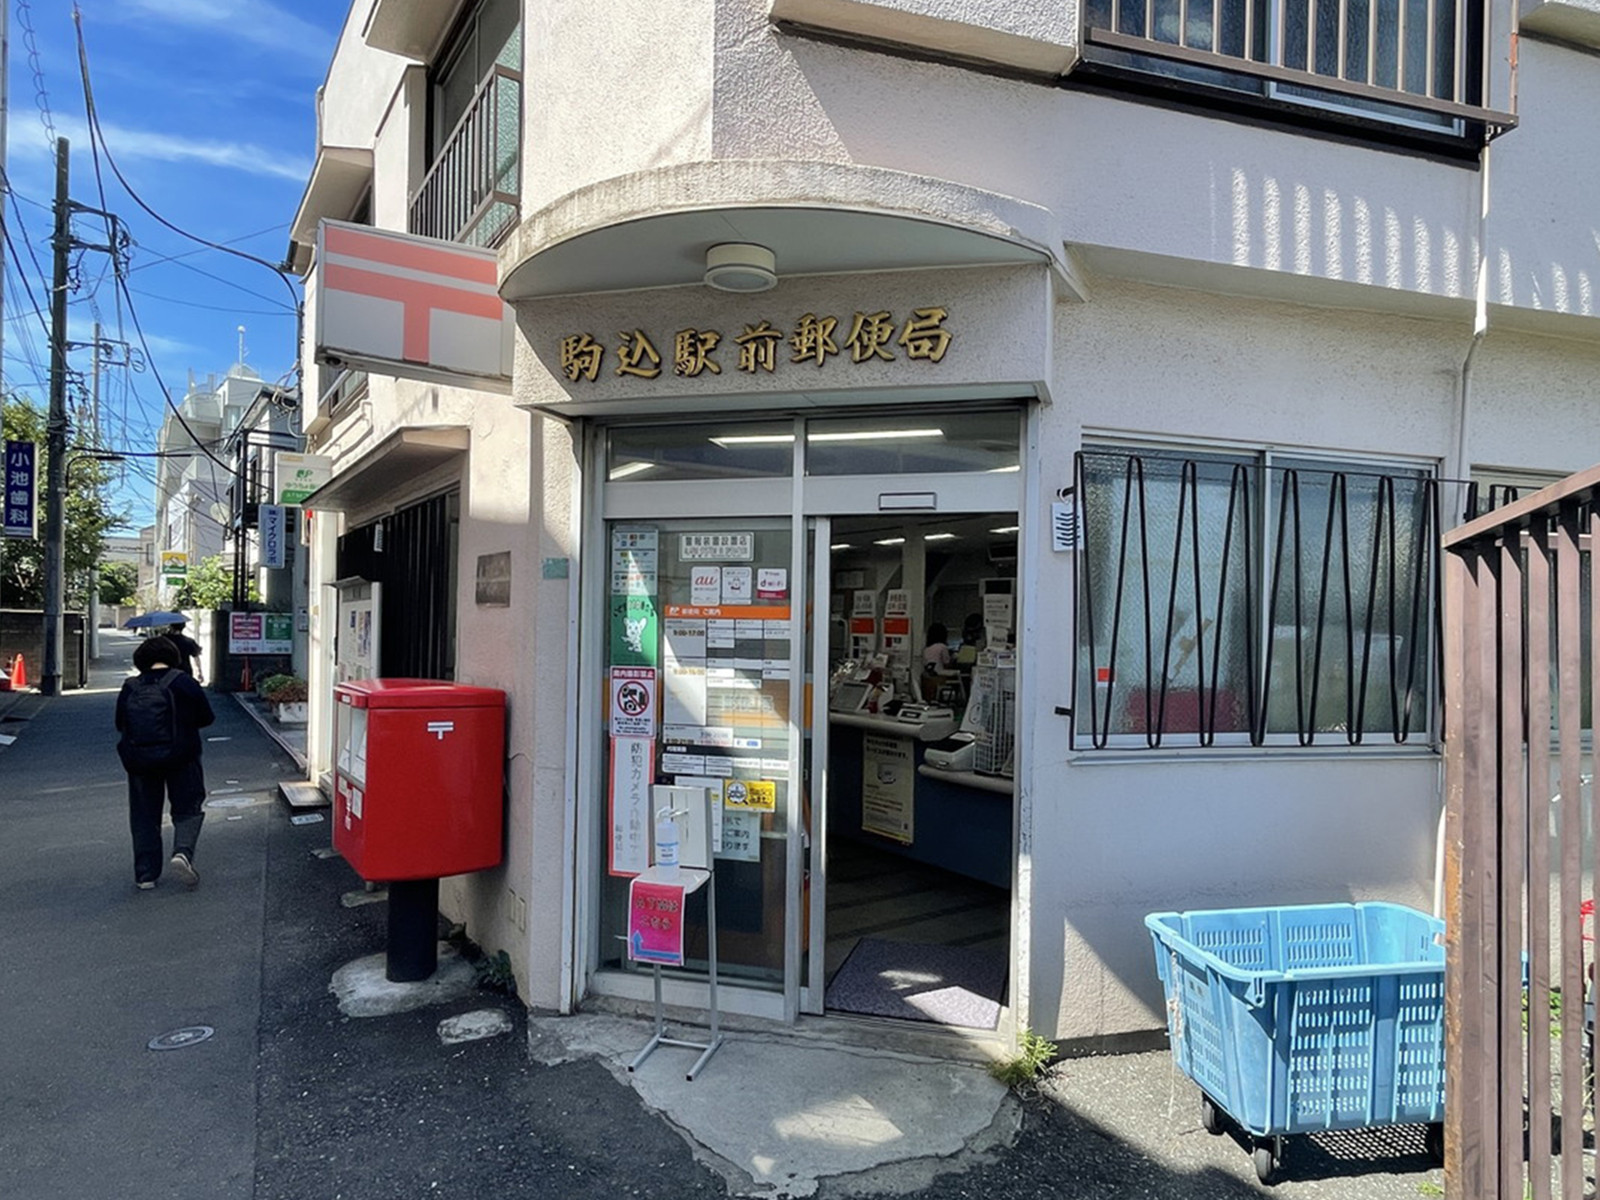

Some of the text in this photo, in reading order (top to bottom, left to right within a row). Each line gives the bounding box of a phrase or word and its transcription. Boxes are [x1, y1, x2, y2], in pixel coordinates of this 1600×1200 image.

[560, 306, 953, 382] 駒込駅前郵便局
[10, 451, 31, 525] 小池歯科
[694, 575, 718, 586] au
[722, 840, 749, 851] ります
